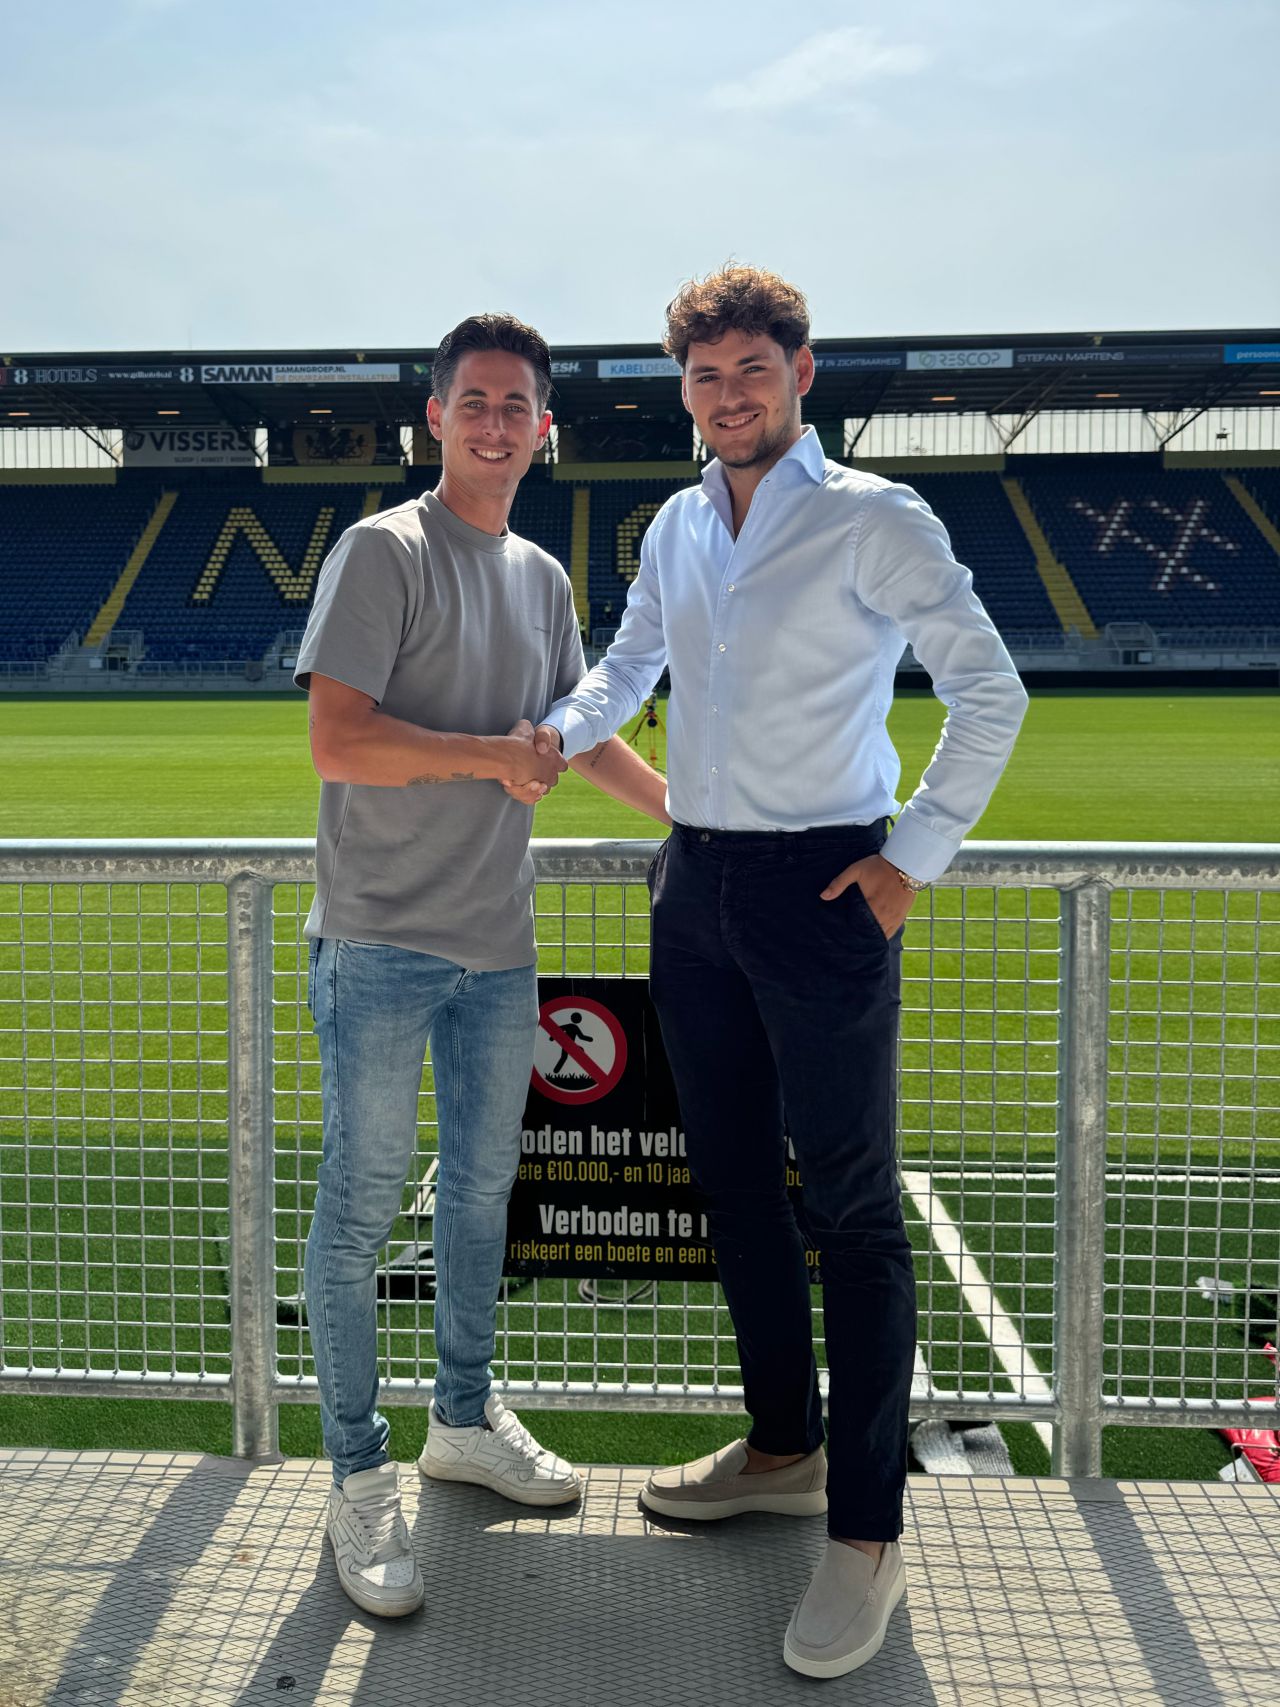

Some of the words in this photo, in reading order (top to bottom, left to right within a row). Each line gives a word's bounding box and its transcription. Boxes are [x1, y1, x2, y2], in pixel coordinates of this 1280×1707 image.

[939, 352, 1000, 367] RESCOP
[1017, 353, 1063, 363] STEFAN
[1066, 351, 1124, 361] MARTENS
[35, 368, 98, 384] HOTELS
[179, 367, 194, 383] 8
[204, 366, 273, 382] SAMAN
[150, 431, 251, 451] VISSERS
[522, 1124, 583, 1155] oden
[591, 1125, 632, 1156] het
[519, 1162, 542, 1181] ete
[547, 1161, 619, 1184] €10.000,-
[624, 1166, 643, 1183] en
[646, 1163, 663, 1183] 10
[667, 1163, 691, 1186] jaa
[539, 1204, 660, 1238] Verboden
[667, 1209, 693, 1238] te
[511, 1240, 571, 1260] riskeert
[575, 1244, 603, 1261] een
[607, 1241, 650, 1262] boete
[655, 1246, 673, 1263] en
[679, 1247, 706, 1264] een
